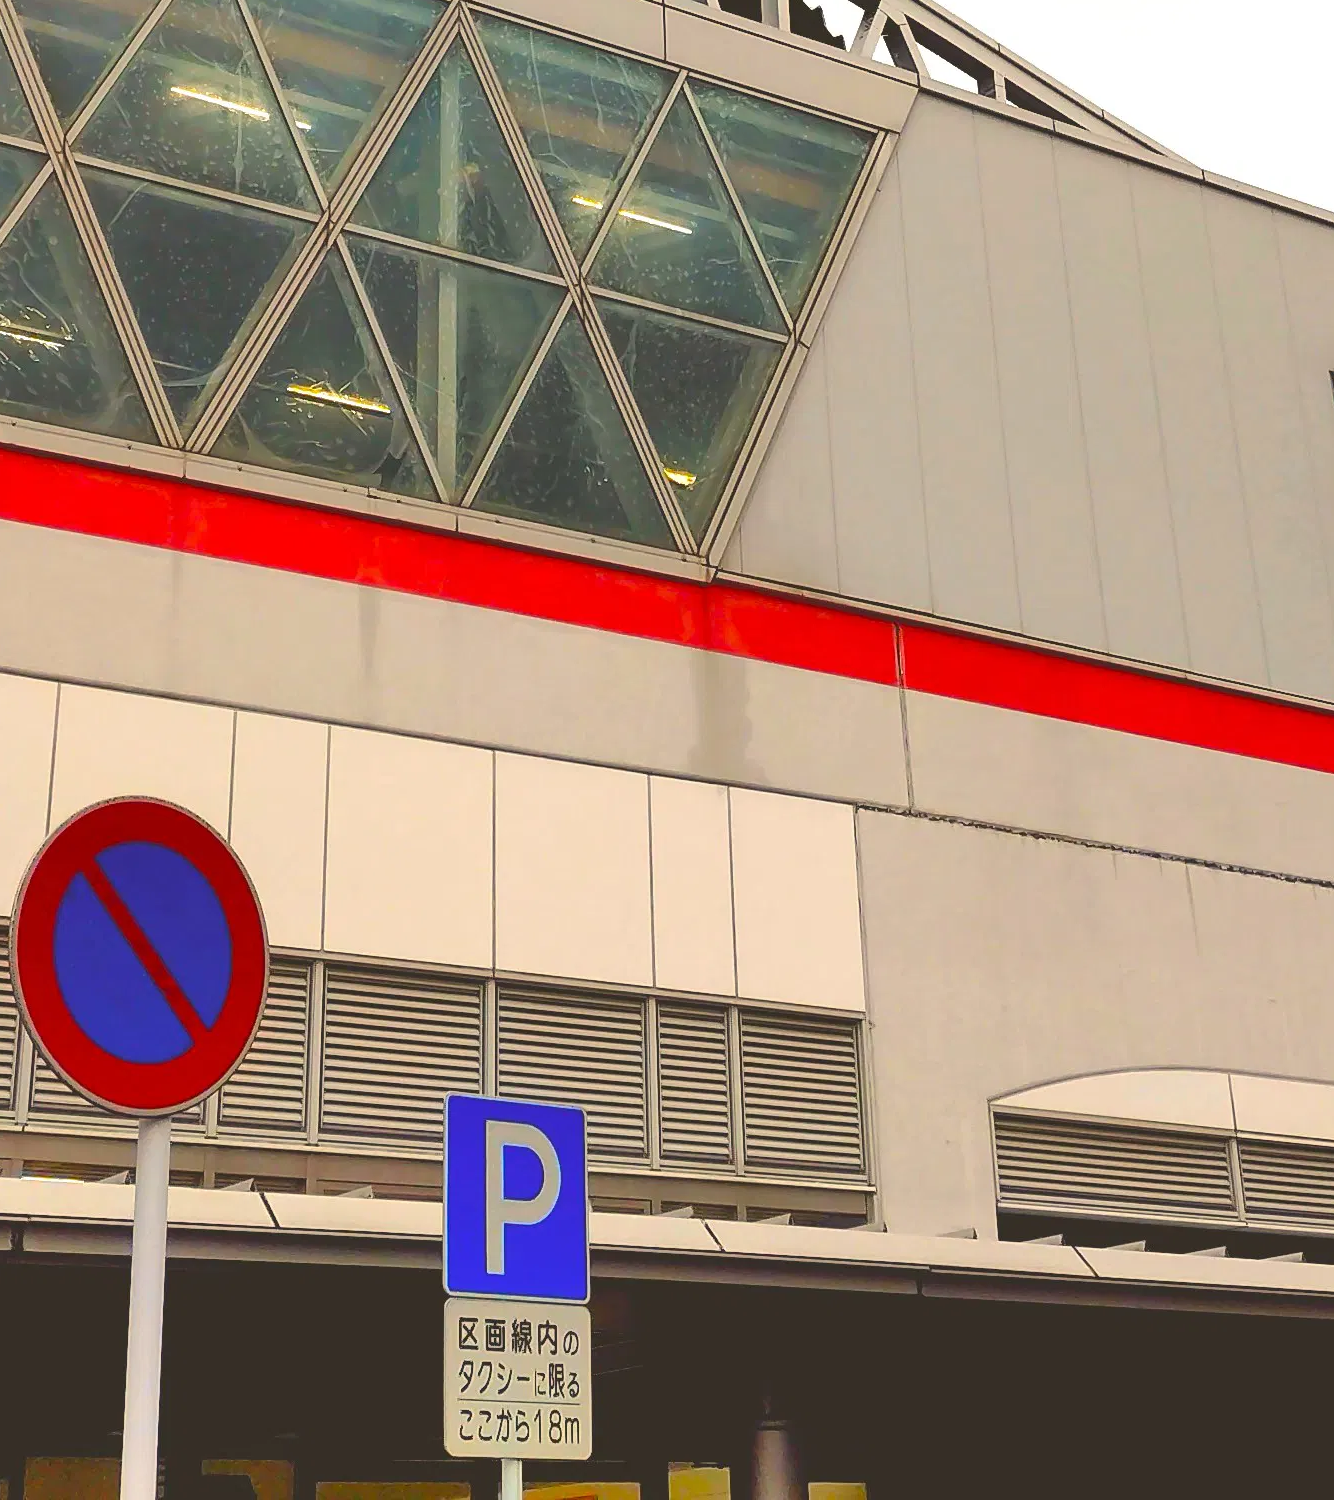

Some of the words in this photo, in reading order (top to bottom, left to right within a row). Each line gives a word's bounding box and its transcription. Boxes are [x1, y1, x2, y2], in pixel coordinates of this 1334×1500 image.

[486, 1119, 561, 1275] P
[458, 1316, 579, 1356] 区画線内の
[458, 1360, 580, 1399] タクシーに限る
[458, 1408, 580, 1445] ここから18m
